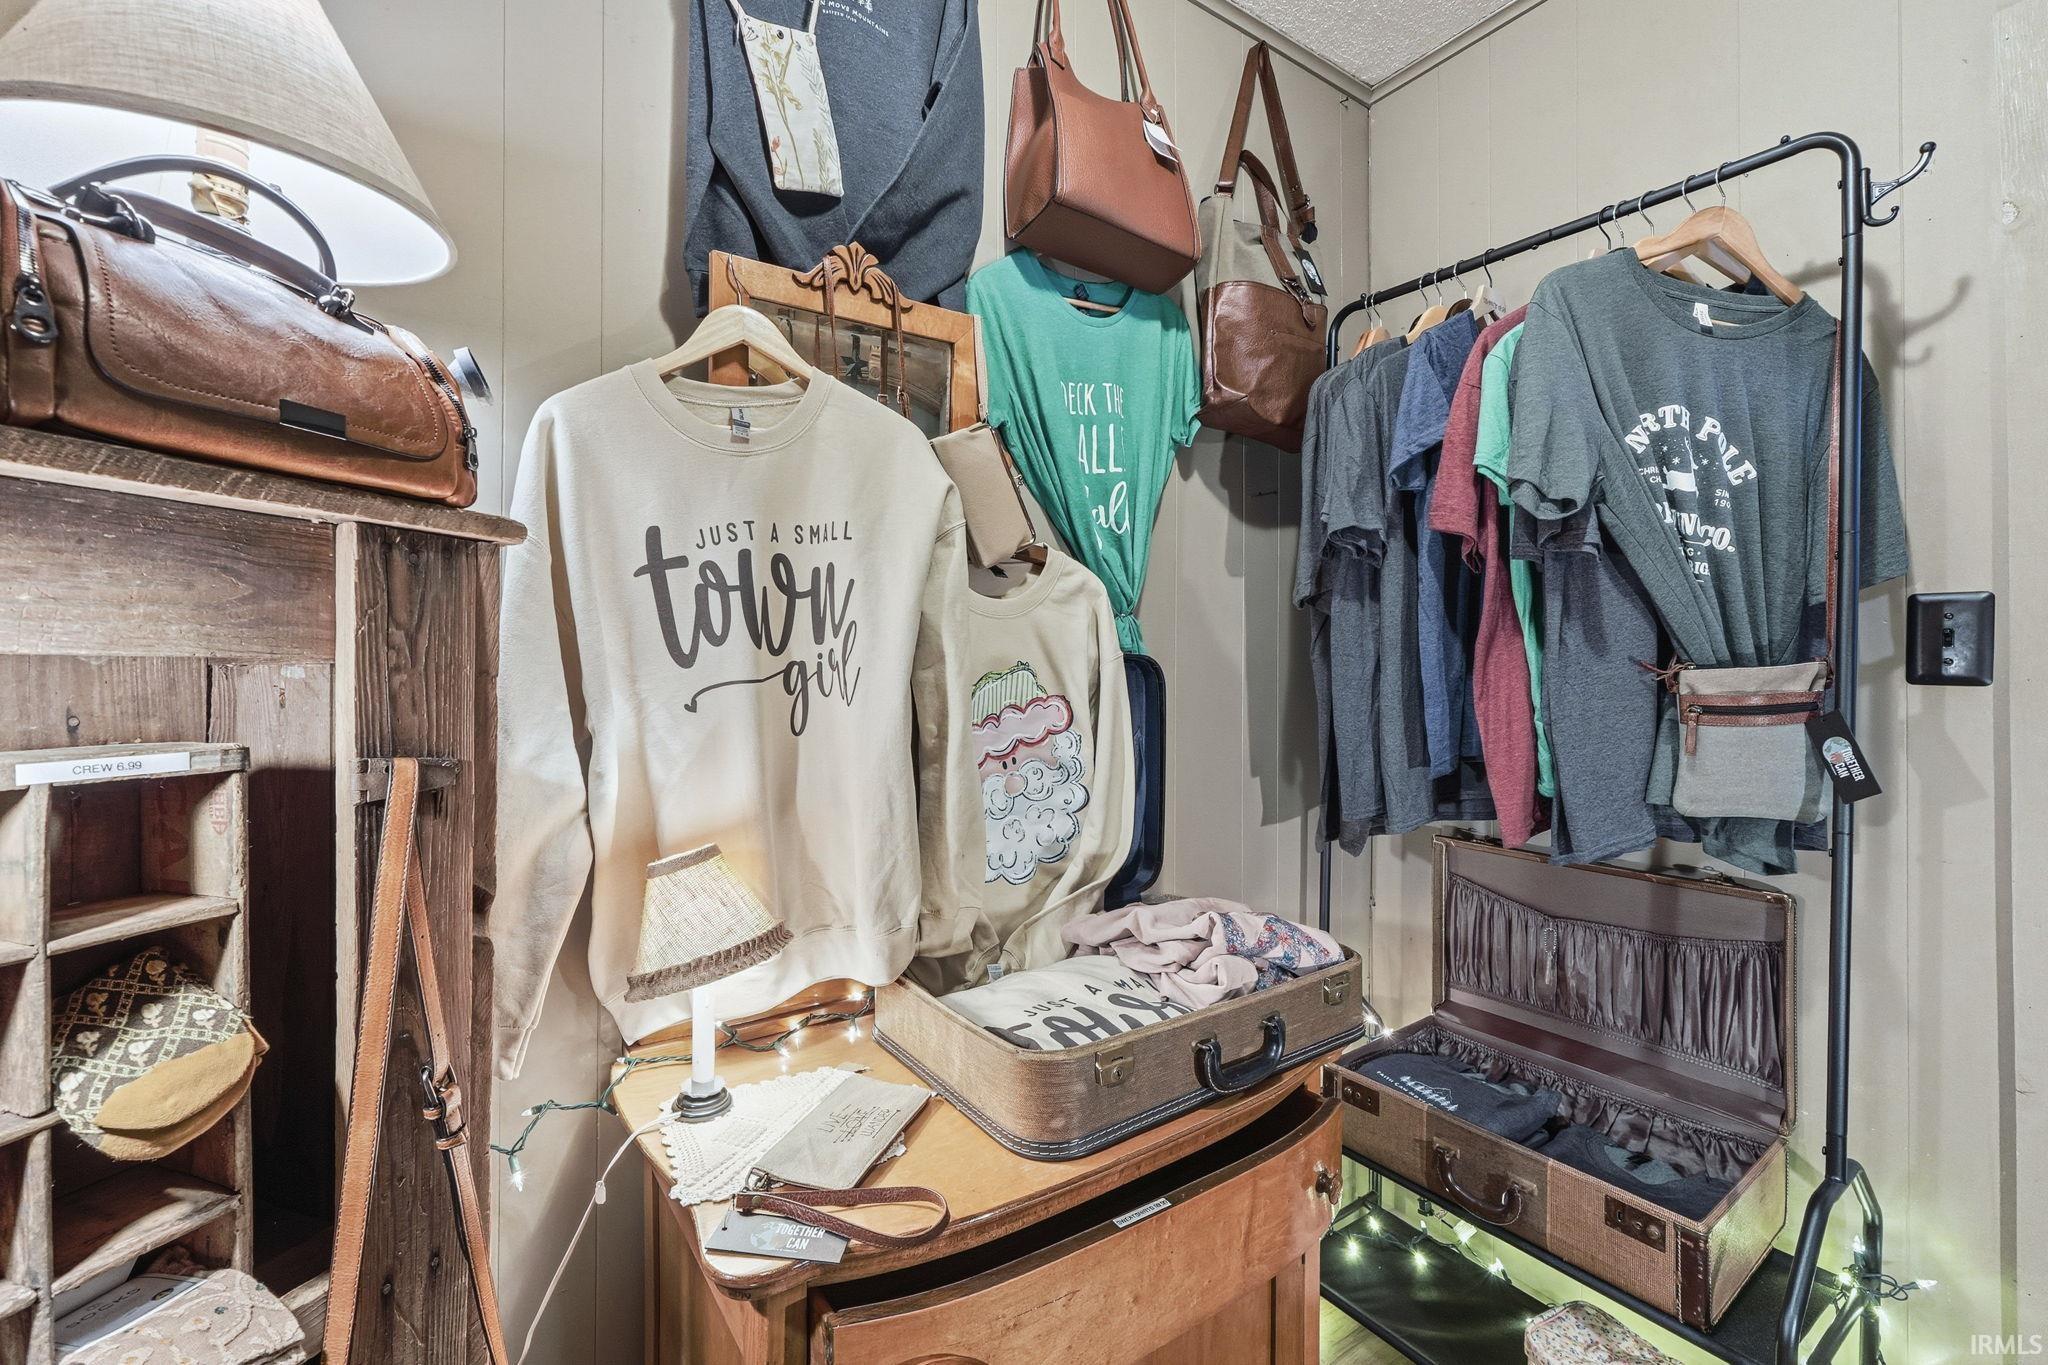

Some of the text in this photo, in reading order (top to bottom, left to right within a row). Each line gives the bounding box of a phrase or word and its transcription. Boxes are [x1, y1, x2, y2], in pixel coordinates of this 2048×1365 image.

[828, 1, 850, 12] MOVE
[1695, 416, 1757, 486] POLE
[696, 520, 853, 549] JUST A SMALL
[633, 525, 855, 669] town
[783, 620, 861, 737] girl
[72, 760, 143, 775] CREW 6.99
[1834, 762, 1851, 779] CAN
[1841, 746, 1866, 782] TOGETHER
[1023, 997, 1077, 1017] JUST
[1084, 984, 1103, 996] A
[775, 1223, 826, 1239] TOGETHER
[785, 1238, 810, 1250] CAN
[65, 1288, 142, 1329] SOCKS
